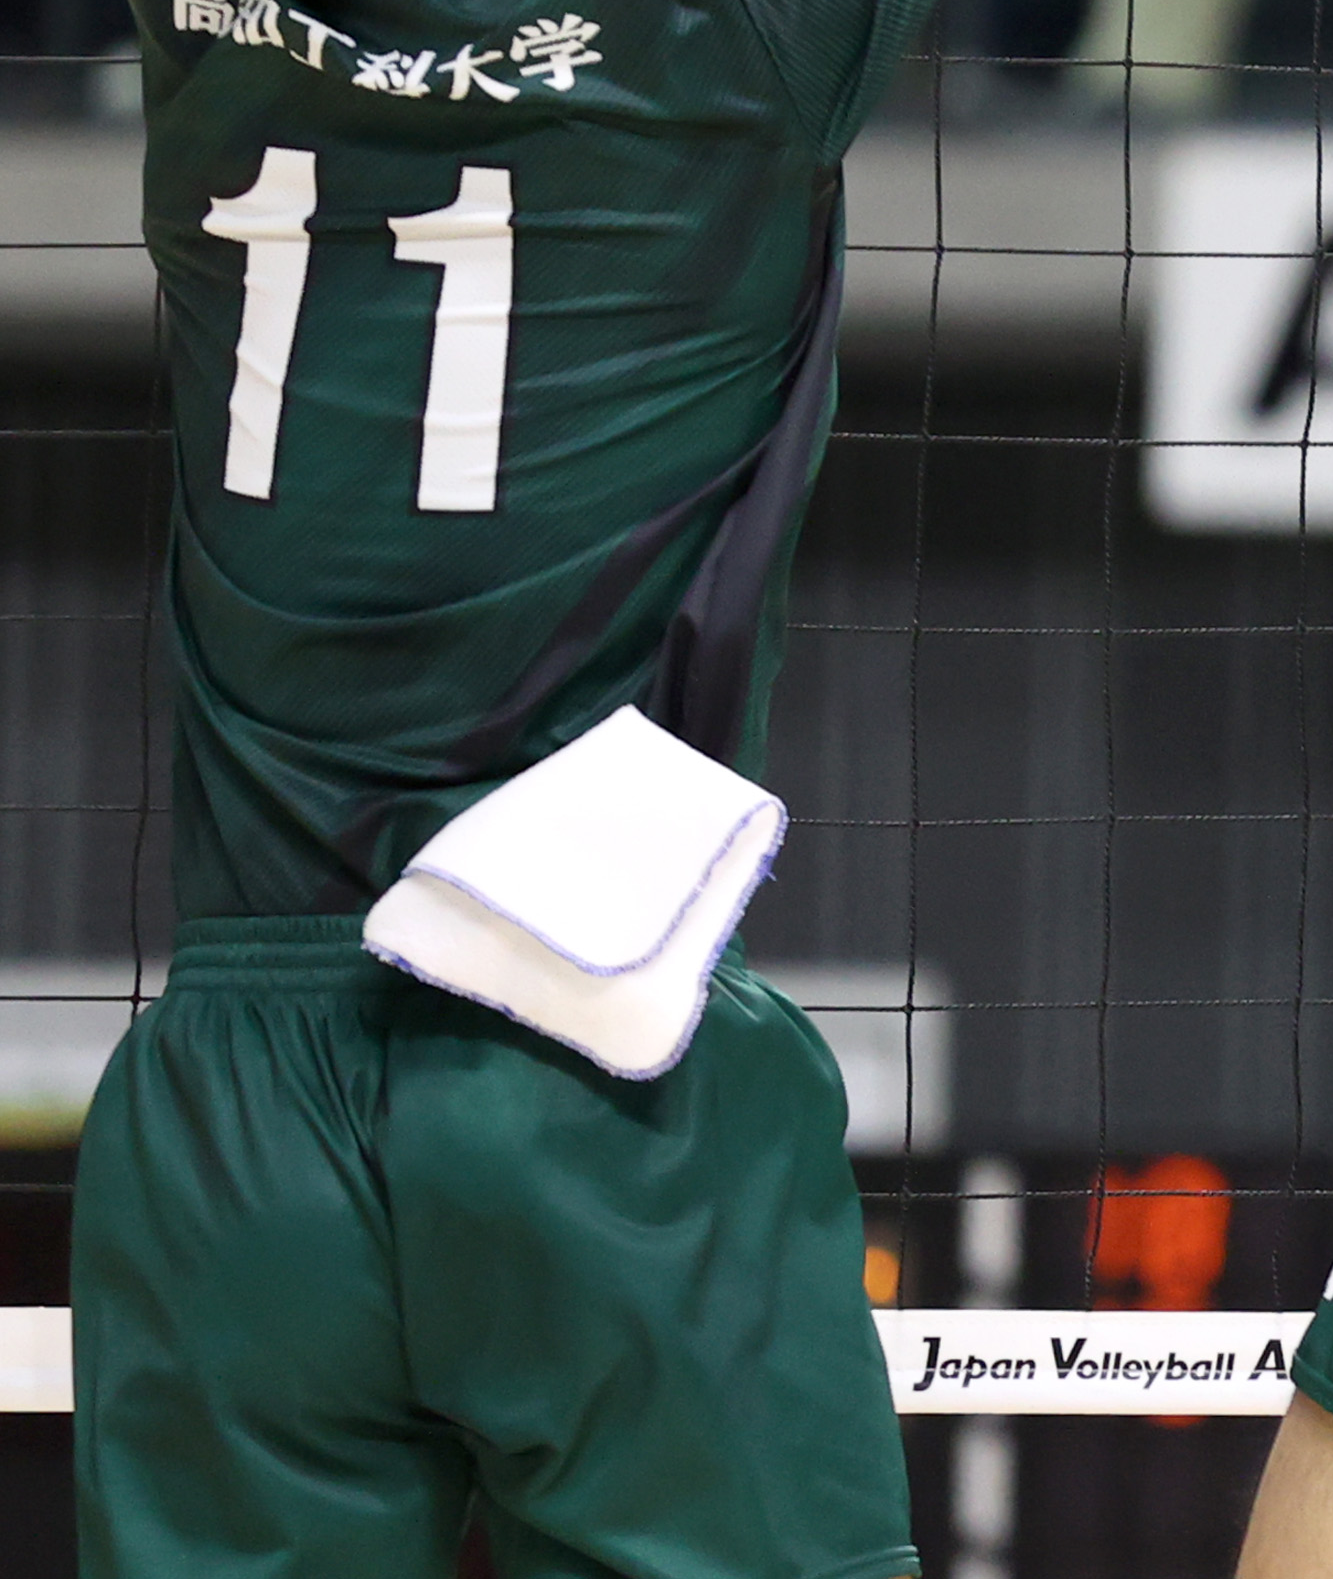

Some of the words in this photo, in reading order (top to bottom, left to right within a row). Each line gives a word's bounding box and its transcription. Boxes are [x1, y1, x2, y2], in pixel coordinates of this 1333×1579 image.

[202, 146, 514, 512] 11
[913, 1336, 1036, 1392] Japan
[1050, 1336, 1236, 1389] Volleyball
